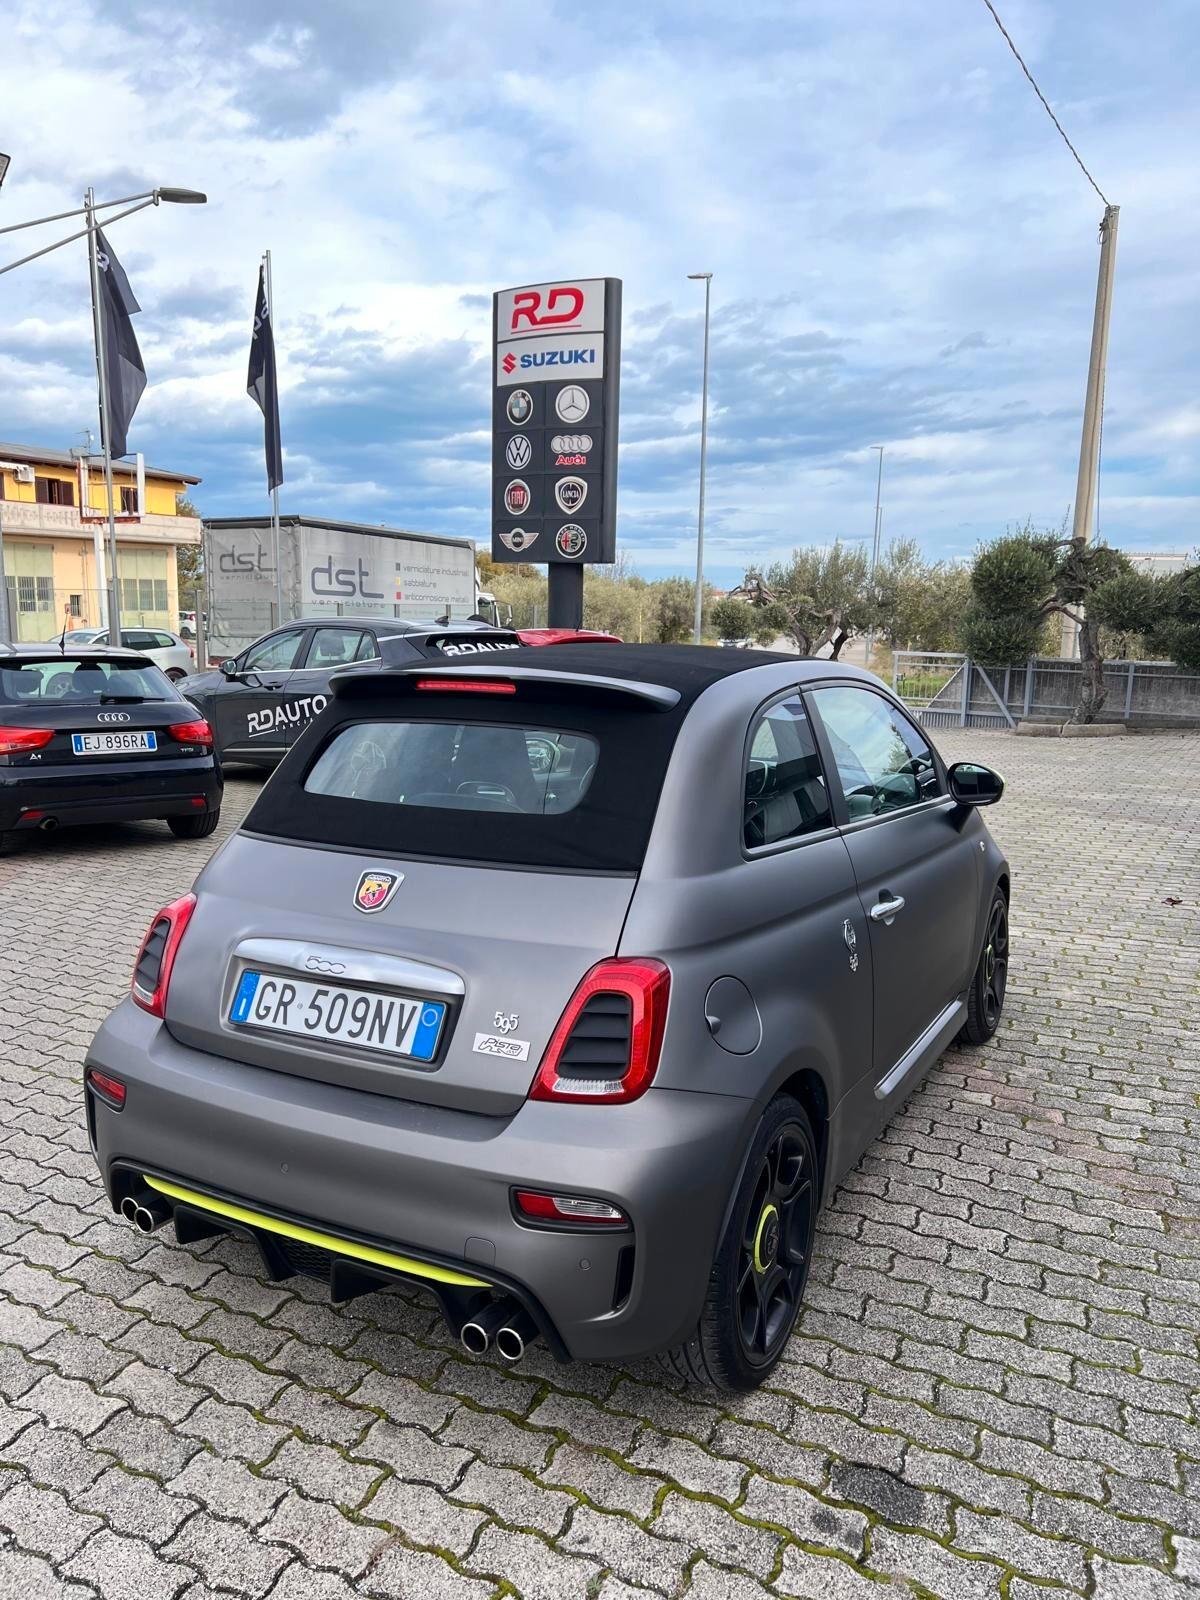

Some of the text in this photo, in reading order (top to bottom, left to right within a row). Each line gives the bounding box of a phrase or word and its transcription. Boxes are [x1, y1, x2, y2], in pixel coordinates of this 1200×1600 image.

[511, 287, 584, 330] RD
[520, 349, 596, 369] SUZUKI
[555, 454, 587, 466] Audi
[511, 490, 524, 505] FIAT
[562, 489, 580, 498] LANCIA
[219, 544, 278, 573] dst
[311, 555, 384, 599] dst
[493, 1010, 520, 1034] 595
